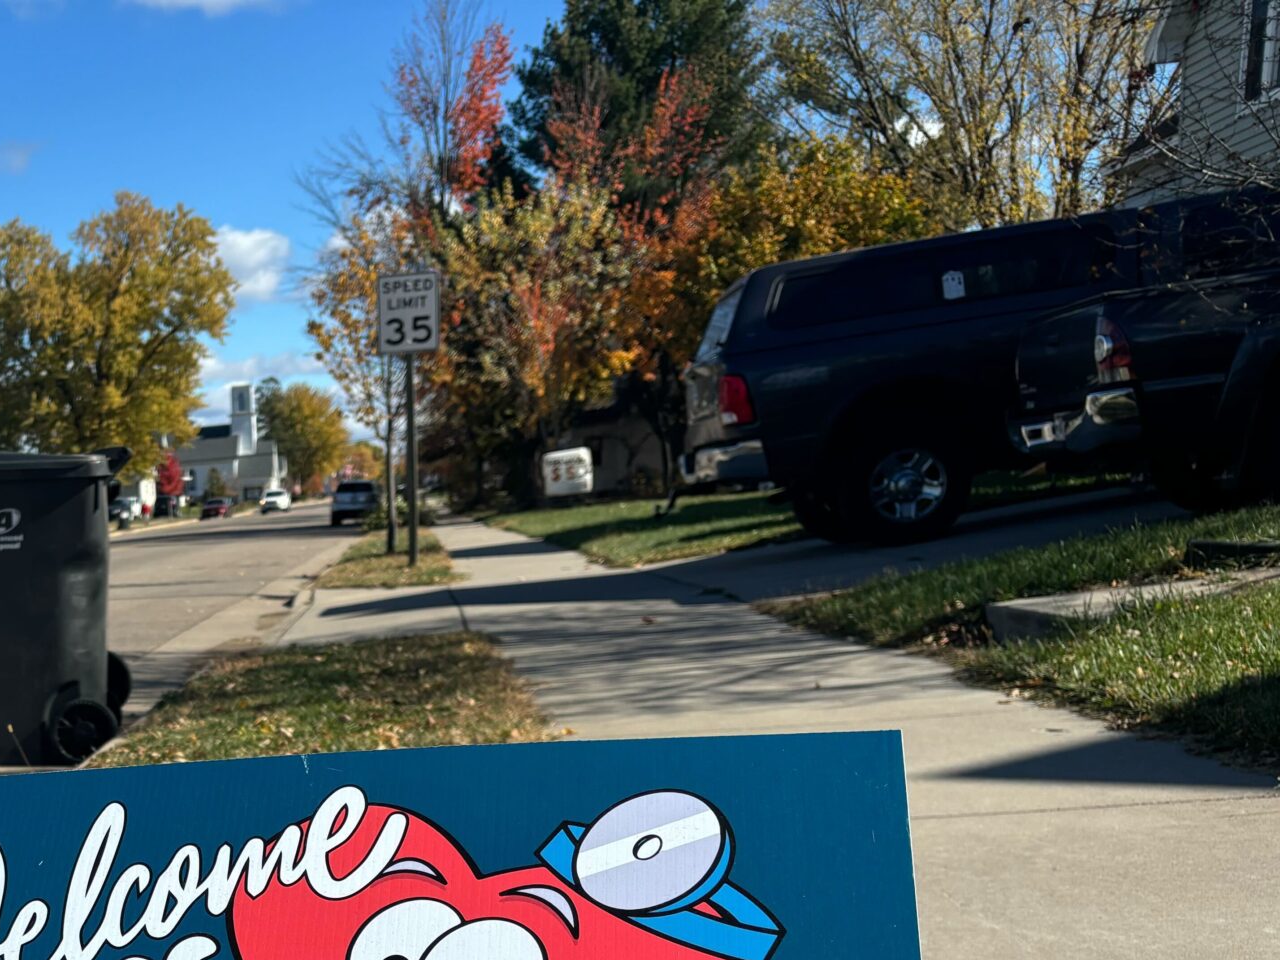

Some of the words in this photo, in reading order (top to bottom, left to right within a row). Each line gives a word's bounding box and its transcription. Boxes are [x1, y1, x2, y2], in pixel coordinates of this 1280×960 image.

[383, 279, 433, 294] SPEED
[388, 296, 427, 310] LIMIT
[386, 315, 432, 345] 35
